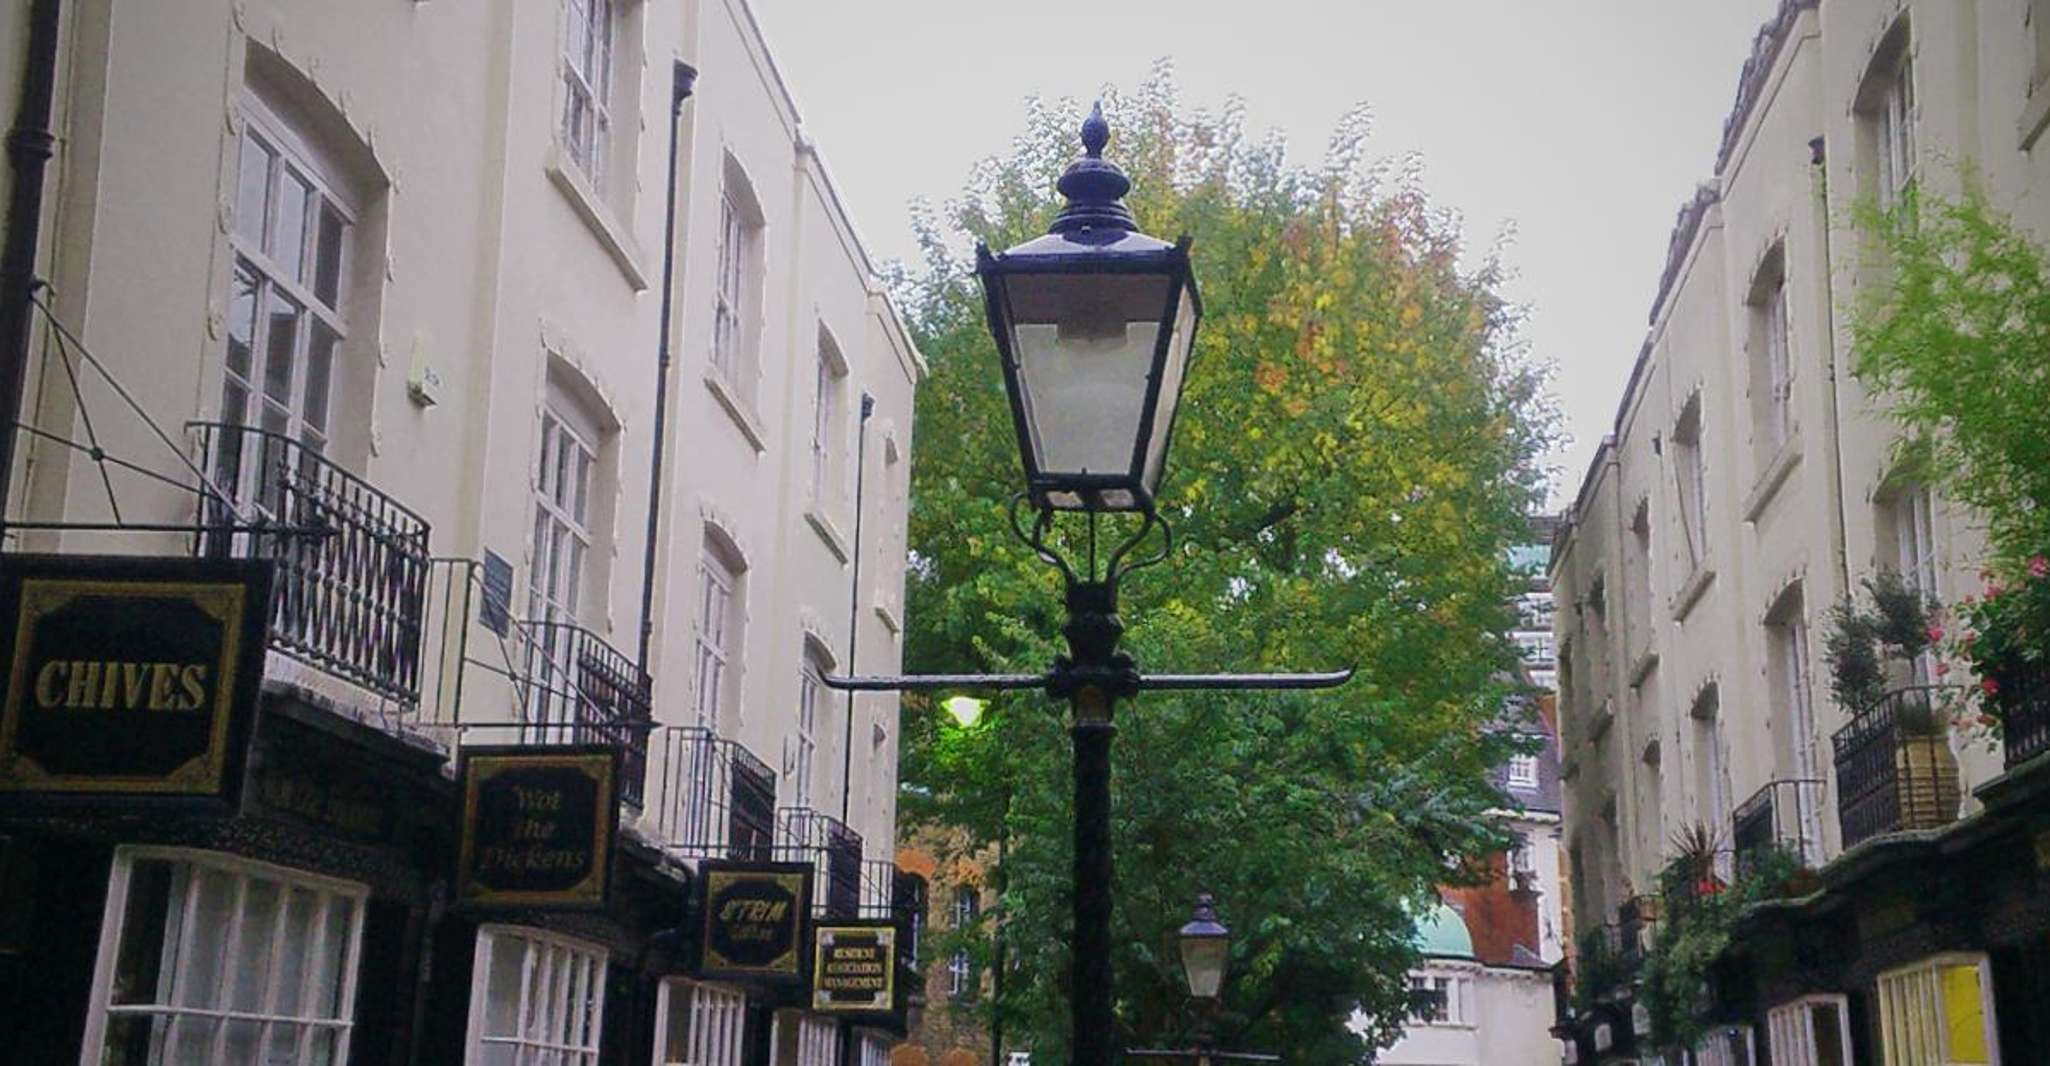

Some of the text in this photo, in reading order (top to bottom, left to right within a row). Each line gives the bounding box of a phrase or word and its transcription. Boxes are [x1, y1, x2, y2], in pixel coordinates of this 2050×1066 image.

[36, 660, 208, 711] CHIVES
[511, 785, 562, 811] Wot
[513, 819, 556, 841] the
[479, 843, 585, 870] Dickens
[824, 977, 883, 989] MANAGEMENT
